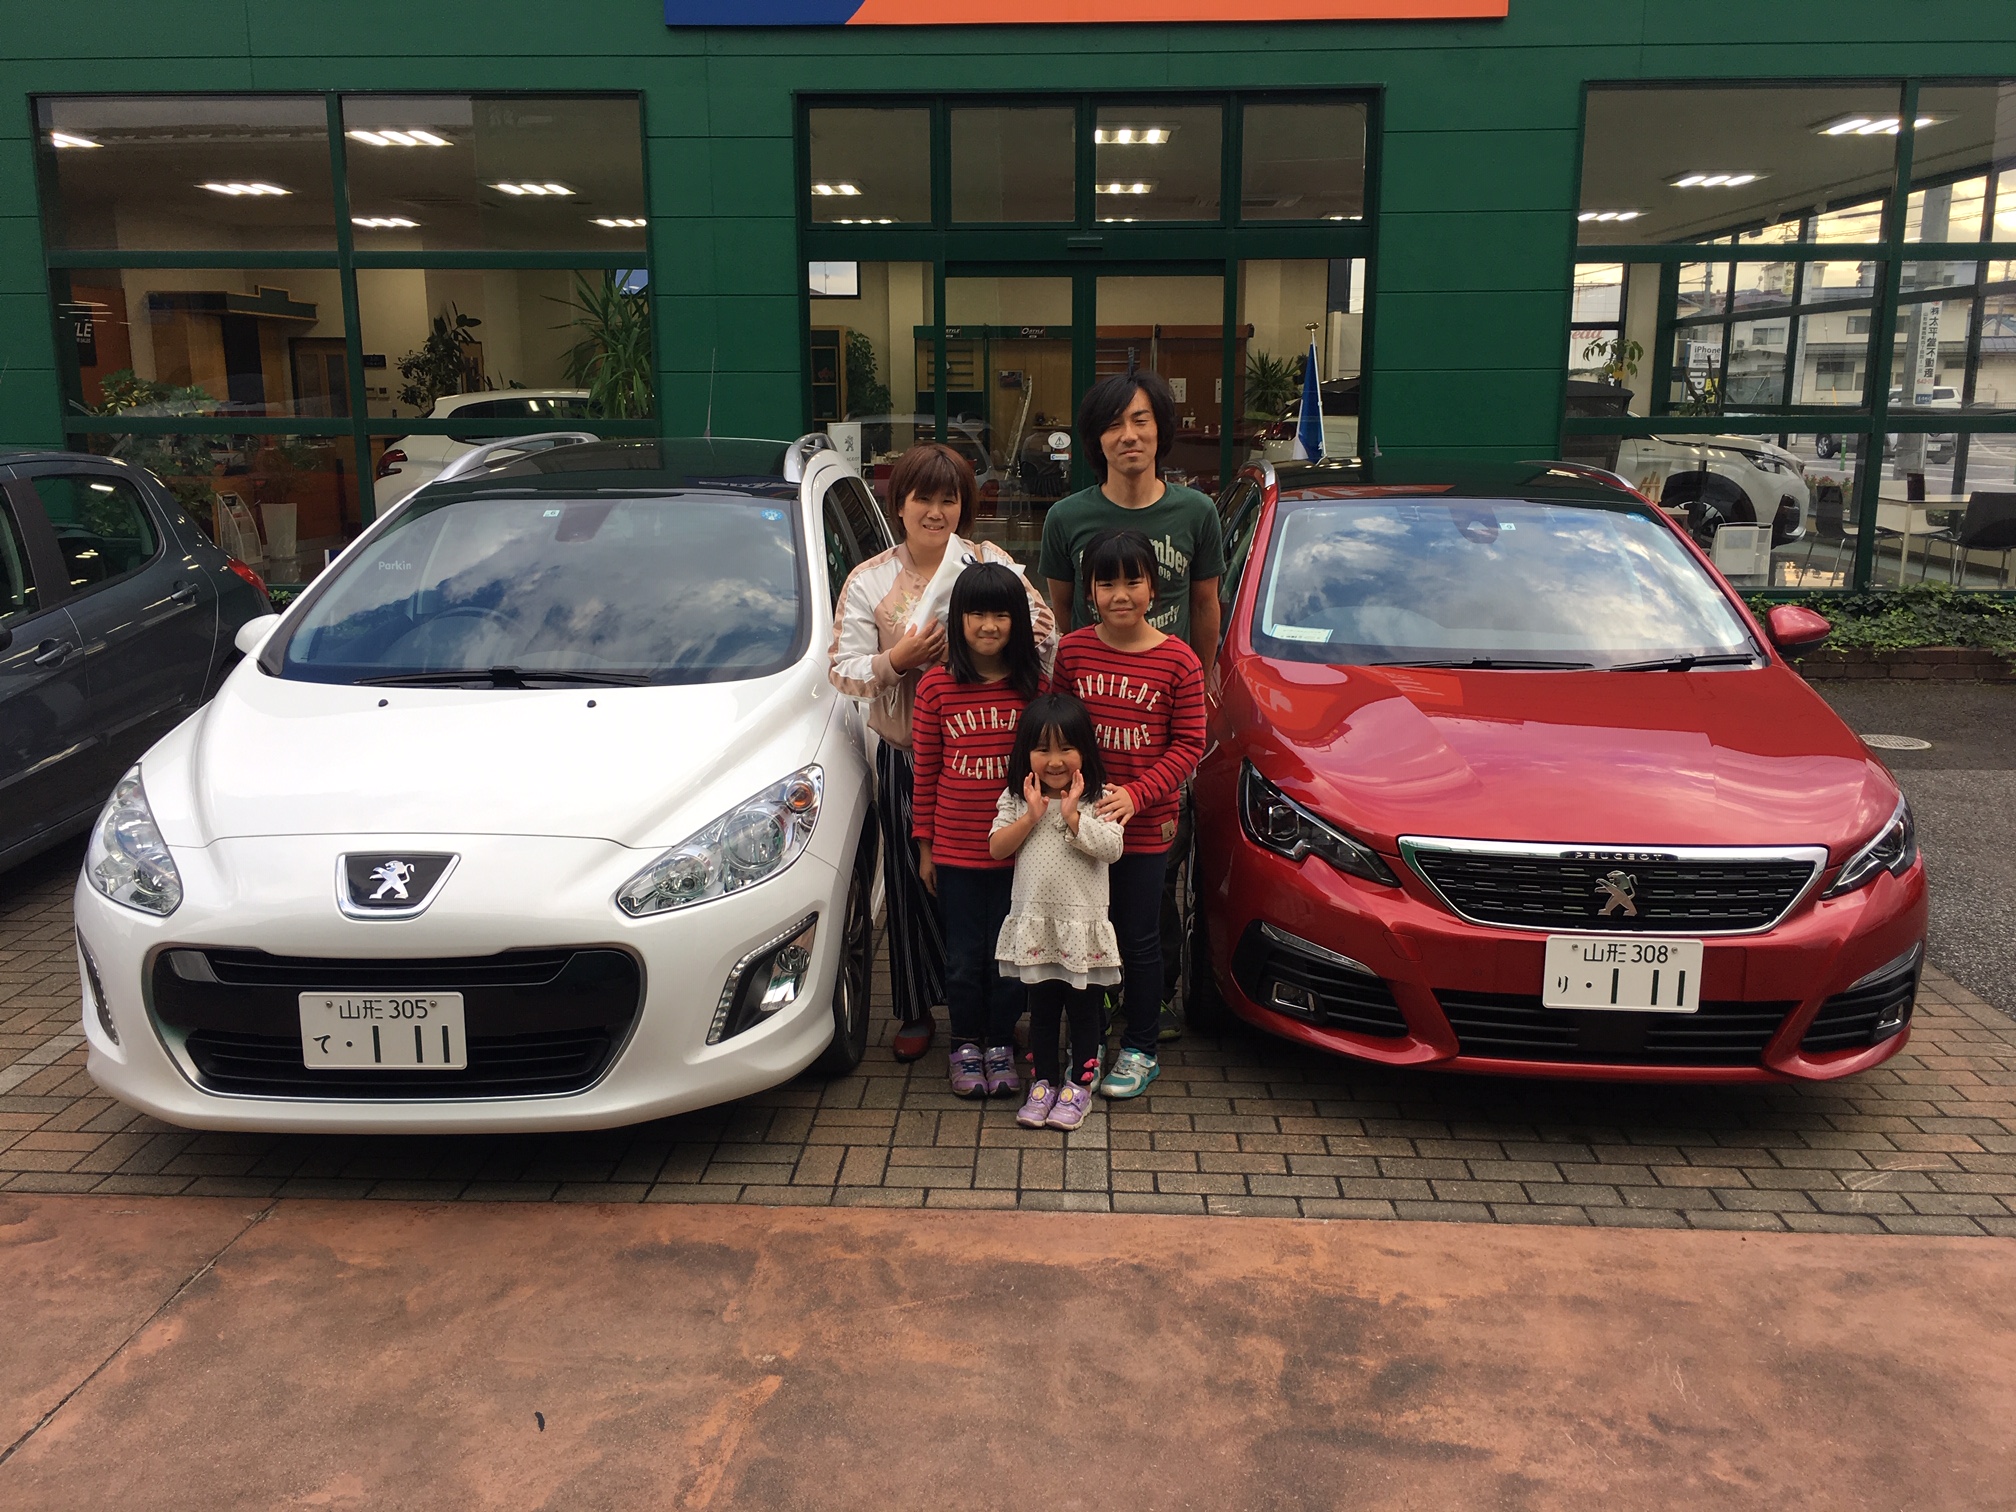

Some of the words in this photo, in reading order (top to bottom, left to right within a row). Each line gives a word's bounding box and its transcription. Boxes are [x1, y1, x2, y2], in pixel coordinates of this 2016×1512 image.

[75, 322, 92, 337] LE
[1694, 345, 1722, 354] iPhone
[378, 561, 412, 571] Parkin
[1149, 534, 1188, 577] mber
[1158, 565, 1171, 581] 018
[1077, 673, 1129, 699] AVOIR
[1135, 682, 1161, 711] DE
[945, 706, 998, 739] AVOIR
[1008, 708, 1017, 731] D
[1095, 723, 1151, 750] CHANGE
[951, 749, 968, 775] LA
[975, 754, 1011, 780] CHAN
